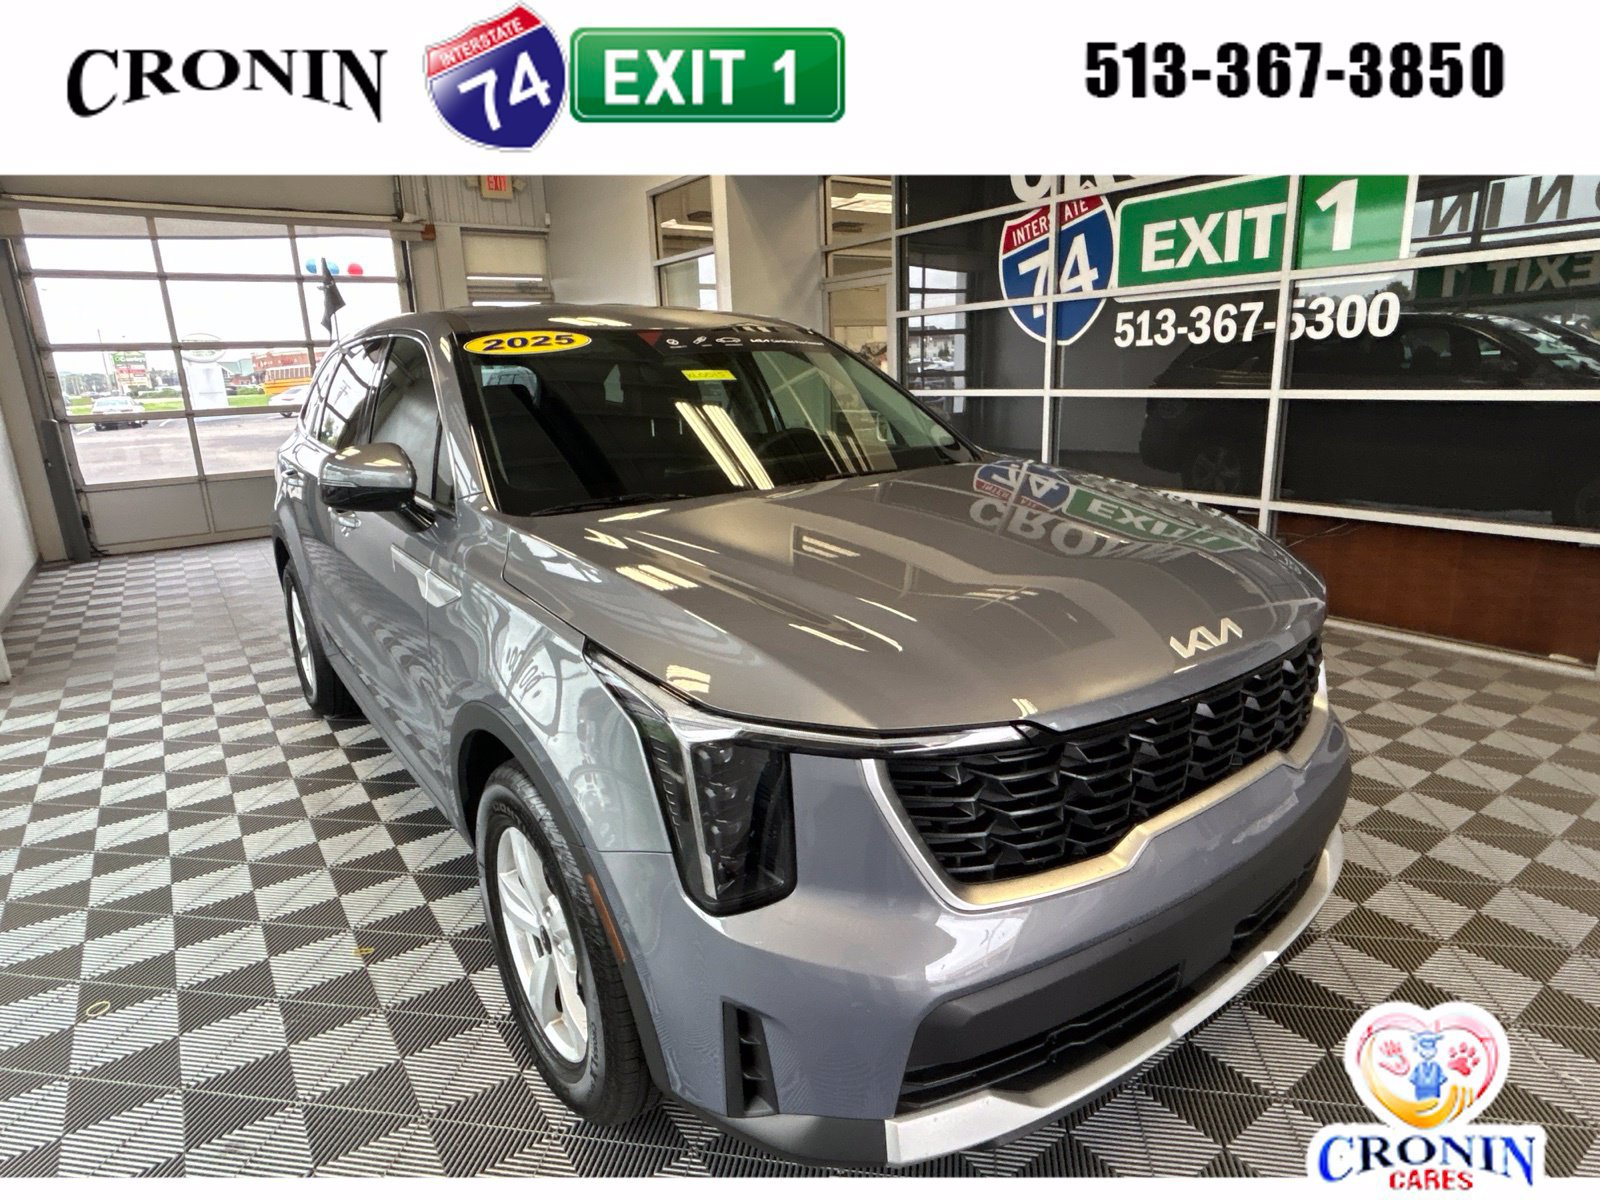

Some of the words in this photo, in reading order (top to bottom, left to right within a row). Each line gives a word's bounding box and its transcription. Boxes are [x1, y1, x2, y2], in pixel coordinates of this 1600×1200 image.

[1141, 201, 1287, 272] EXIT
[1315, 179, 1358, 251] 1
[1017, 233, 1099, 319] 74
[482, 334, 575, 352] 2025
[1113, 291, 1401, 348] 513-367-5300
[1169, 617, 1243, 659] KIA
